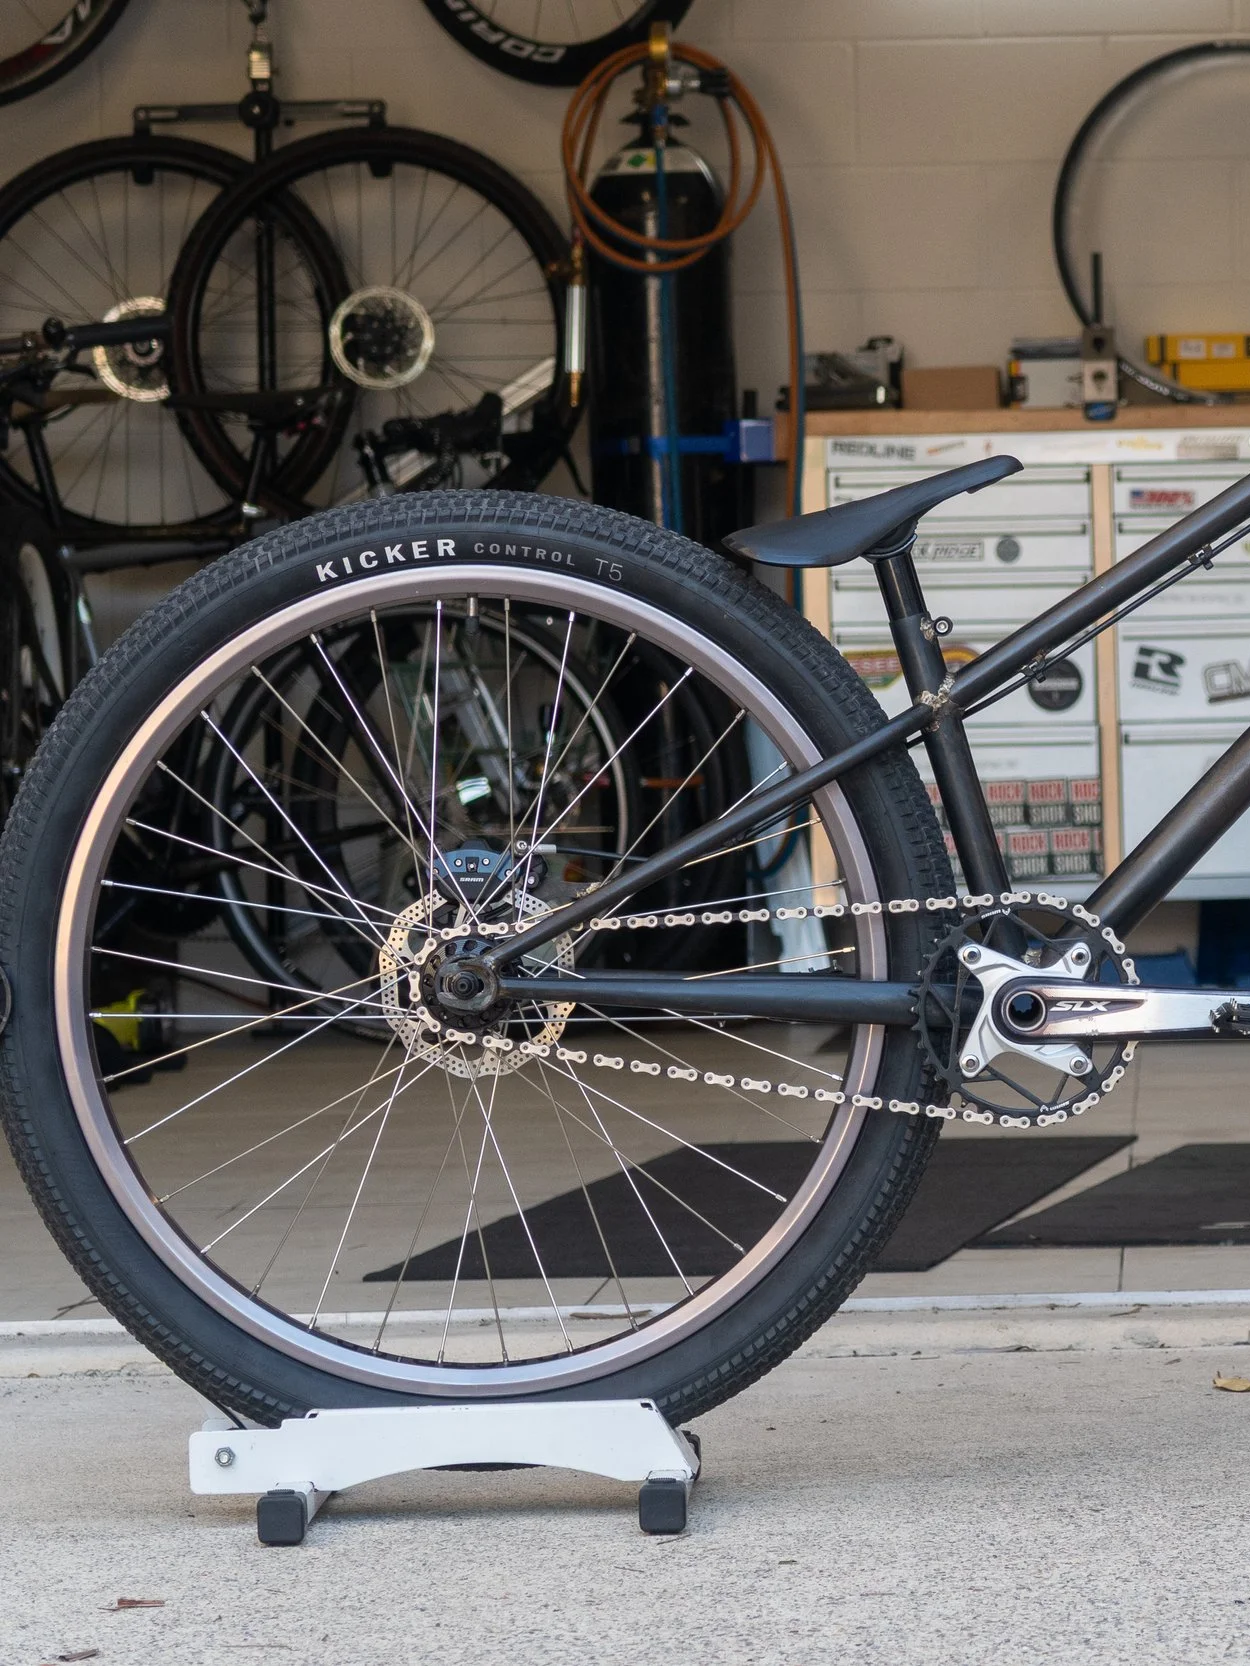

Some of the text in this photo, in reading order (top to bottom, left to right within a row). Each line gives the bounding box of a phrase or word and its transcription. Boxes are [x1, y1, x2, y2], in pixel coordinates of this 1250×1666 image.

[315, 539, 624, 582] KICKER CONTROL T5
[1074, 782, 1099, 799] ROC
[1075, 804, 1099, 823] SHO
[1050, 1000, 1111, 1012] SLX
